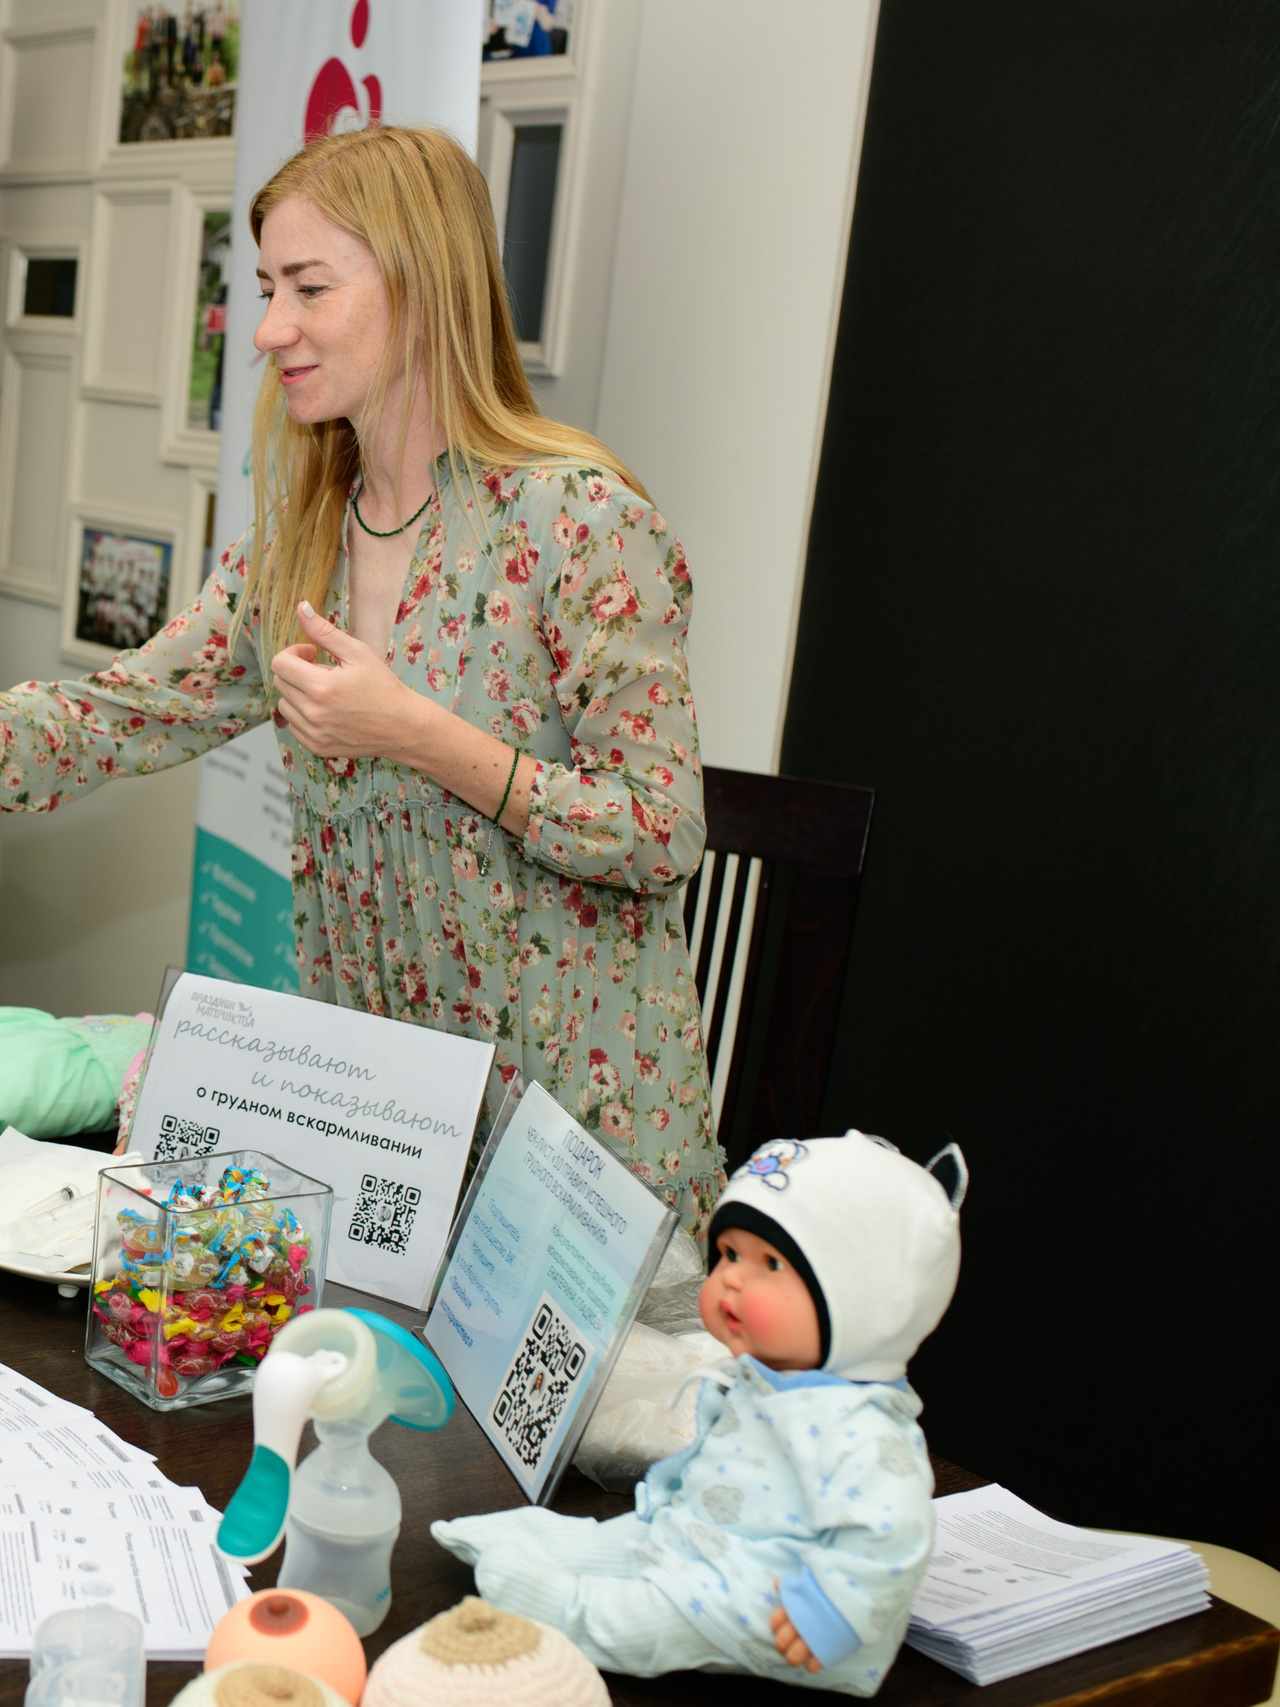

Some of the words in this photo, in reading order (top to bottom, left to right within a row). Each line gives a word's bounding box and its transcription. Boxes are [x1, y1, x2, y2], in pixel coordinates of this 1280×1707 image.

[191, 991, 237, 1010] ПРАЗДНИК
[196, 1003, 255, 1028] МАТЕРИНСТВА
[173, 1018, 377, 1082] рассказывают
[196, 1086, 206, 1098] о
[211, 1090, 282, 1120] грудном
[286, 1110, 423, 1159] вскармливании
[251, 1070, 274, 1087] и
[280, 1080, 462, 1138] показывают
[523, 1151, 554, 1188] ГРУДНОГО
[562, 1129, 606, 1180] ПОДАРОК
[527, 1125, 554, 1160] ЧЕК-ЛИСТ
[561, 1161, 588, 1195] ПРАВИЛ
[584, 1184, 627, 1234] УСПЕШНОГО
[471, 1240, 495, 1275] Напишите
[478, 1219, 507, 1258] сообщество
[460, 1258, 485, 1295] сообщения
